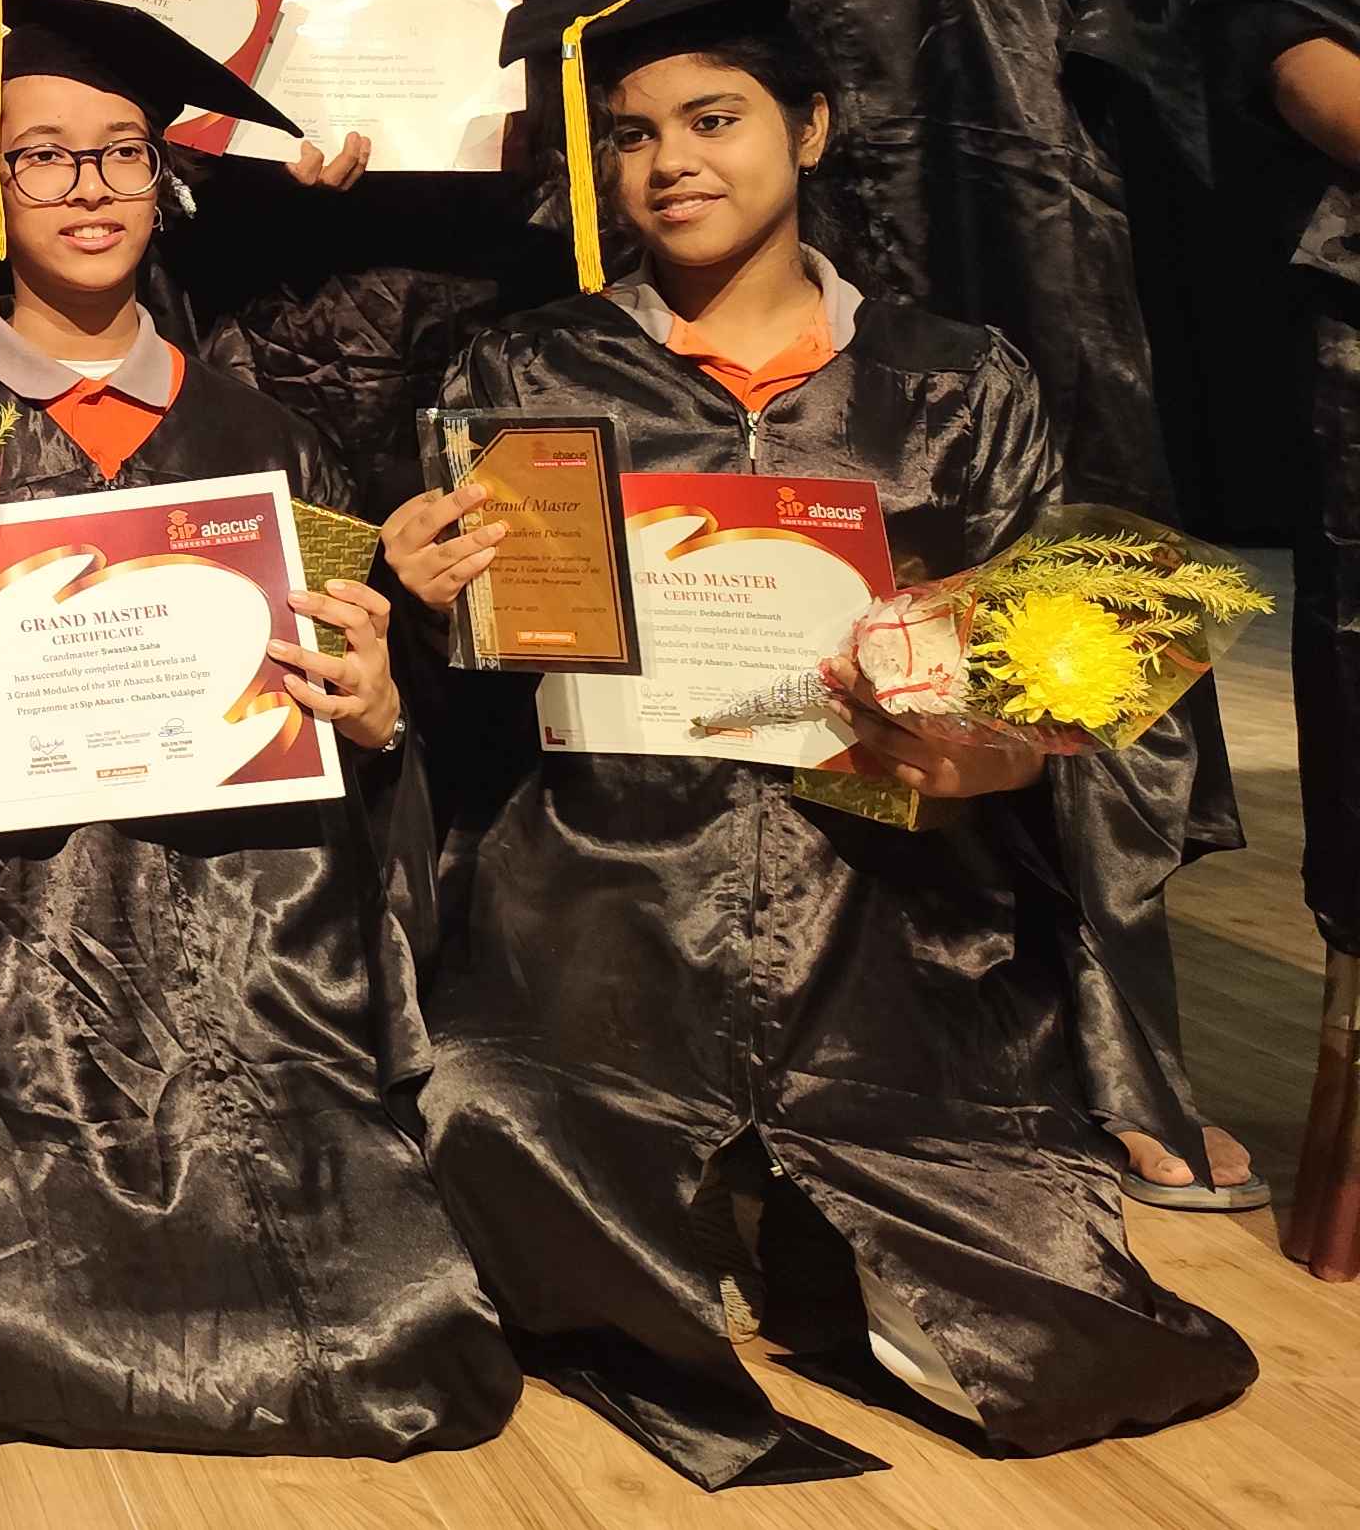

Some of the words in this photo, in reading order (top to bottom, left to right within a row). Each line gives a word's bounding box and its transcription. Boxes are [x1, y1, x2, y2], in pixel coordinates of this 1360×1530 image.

[483, 496, 530, 512] Grand
[532, 499, 581, 512] Master
[807, 502, 863, 521] abacus
[200, 517, 260, 538] abacus
[704, 573, 778, 590] MASTER
[663, 590, 753, 605] CERTIFICATE
[20, 613, 87, 633] GRAND
[92, 604, 169, 625] MASTER
[51, 625, 145, 646] CERTIFICATE
[42, 649, 99, 663] Grandmaster
[100, 644, 138, 656] Swastika
[139, 641, 161, 651] Saha
[14, 673, 30, 683] has
[31, 665, 83, 681] successfully
[84, 662, 130, 677] completed
[131, 660, 142, 669] all
[151, 656, 179, 667] Levels
[180, 653, 197, 664] and
[14, 689, 41, 700] Grand
[42, 685, 80, 697] Modules
[81, 682, 91, 692] of
[91, 680, 105, 690] the
[123, 675, 155, 687] Abacus
[165, 670, 189, 682] Brain
[17, 702, 68, 717] Programme
[80, 698, 94, 710] Sip
[94, 695, 125, 707] Abacus
